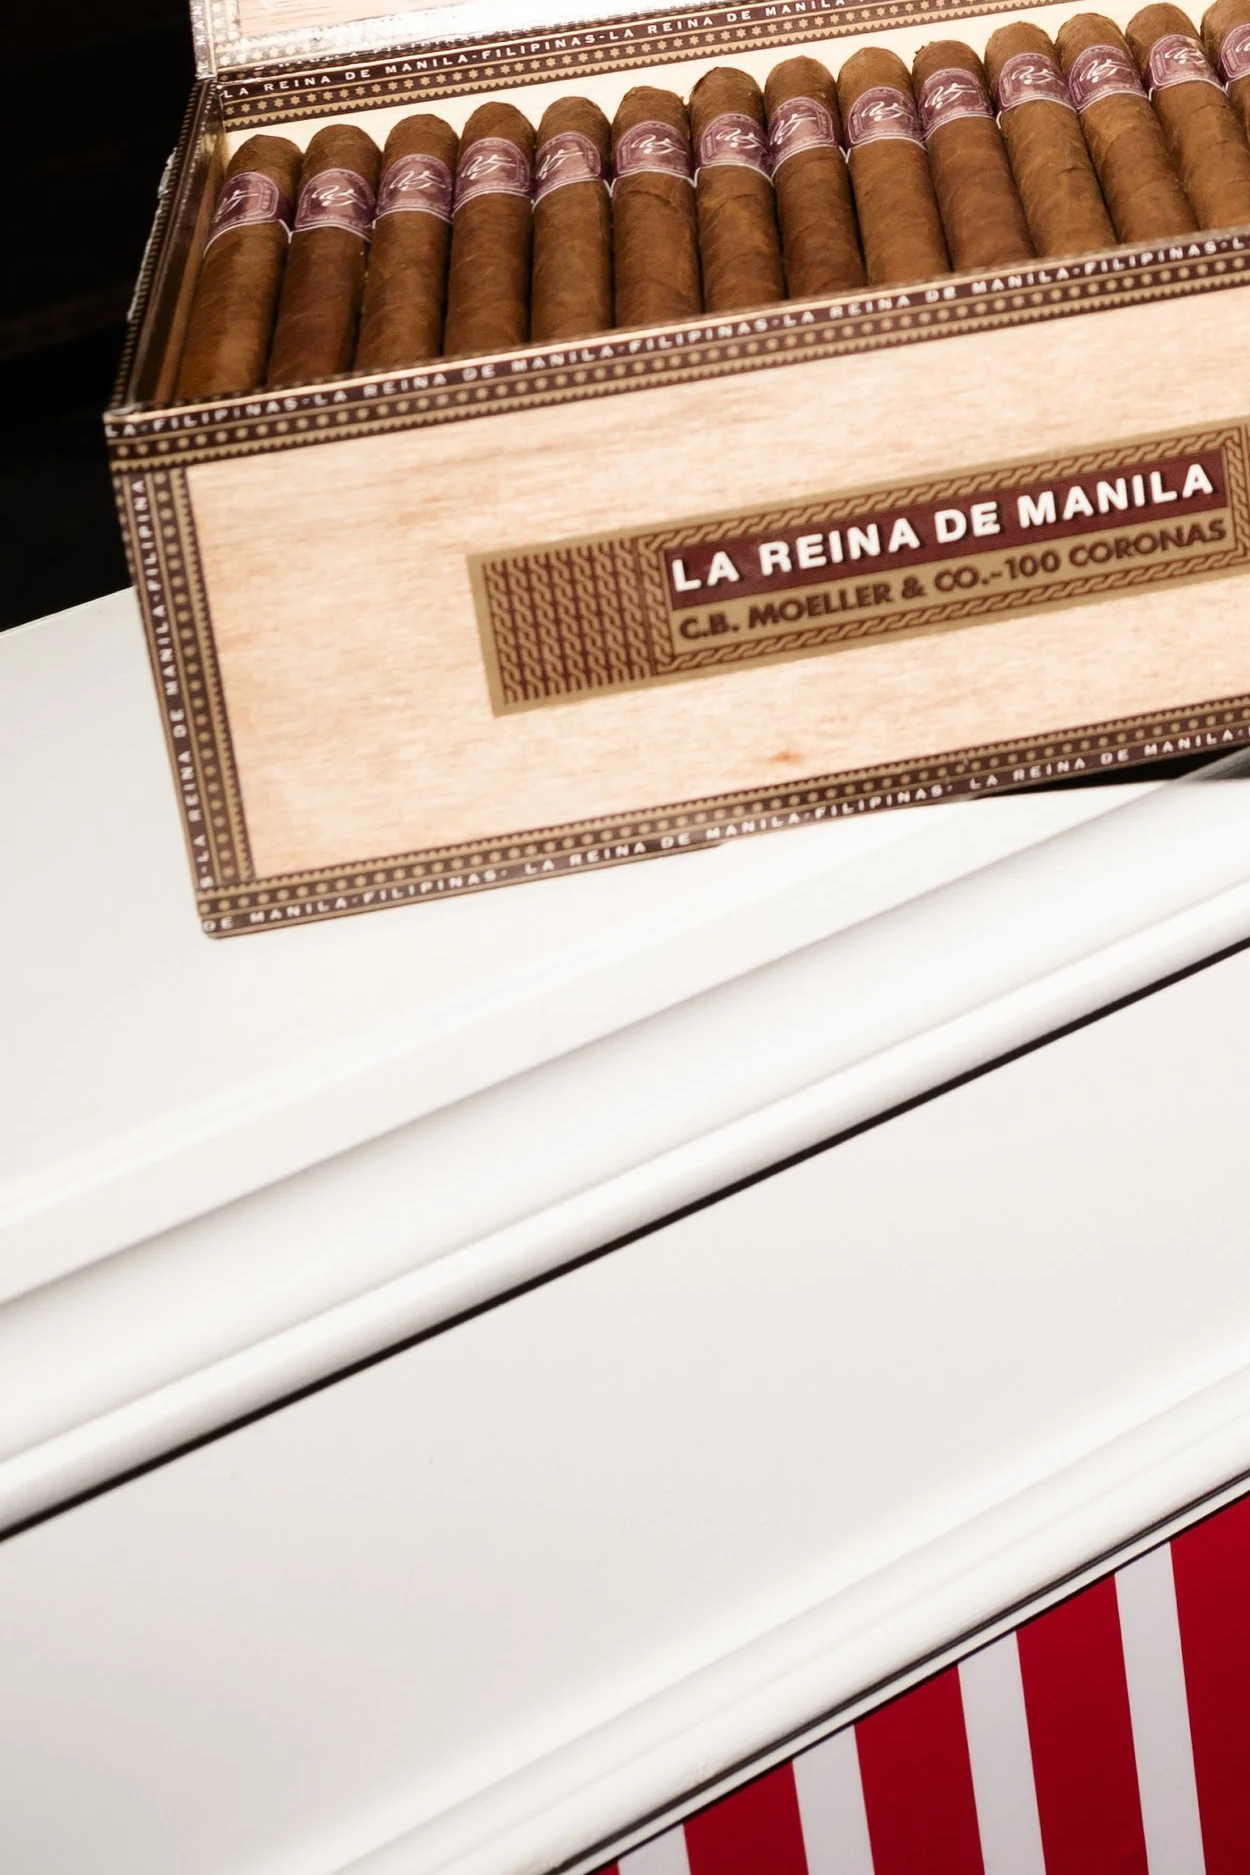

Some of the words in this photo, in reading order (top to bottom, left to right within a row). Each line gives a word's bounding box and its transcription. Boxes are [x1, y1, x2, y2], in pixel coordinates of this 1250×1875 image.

[222, 86, 250, 100] LA
[263, 73, 331, 93] REINA
[344, 67, 371, 81] DE
[646, 15, 714, 35] REINA
[725, 9, 752, 23] DE
[362, 371, 448, 398] REINA
[461, 363, 496, 382] DE
[828, 294, 911, 320] REINA
[924, 284, 957, 304] DE
[671, 550, 741, 593] LA
[758, 517, 921, 576] REINA
[933, 500, 1001, 545] DE
[1016, 462, 1214, 529] MANILA
[678, 611, 741, 640] C.B.
[748, 581, 895, 629] MOELLER
[901, 575, 927, 601] &
[1067, 518, 1228, 568] CORONAS
[169, 707, 188, 738] DE
[177, 749, 203, 822] REINA
[524, 857, 555, 875] LA
[568, 839, 647, 867] REINA
[659, 831, 692, 849] DE
[968, 773, 999, 791] LA
[1012, 757, 1087, 783] REINA
[1098, 748, 1130, 766] DE
